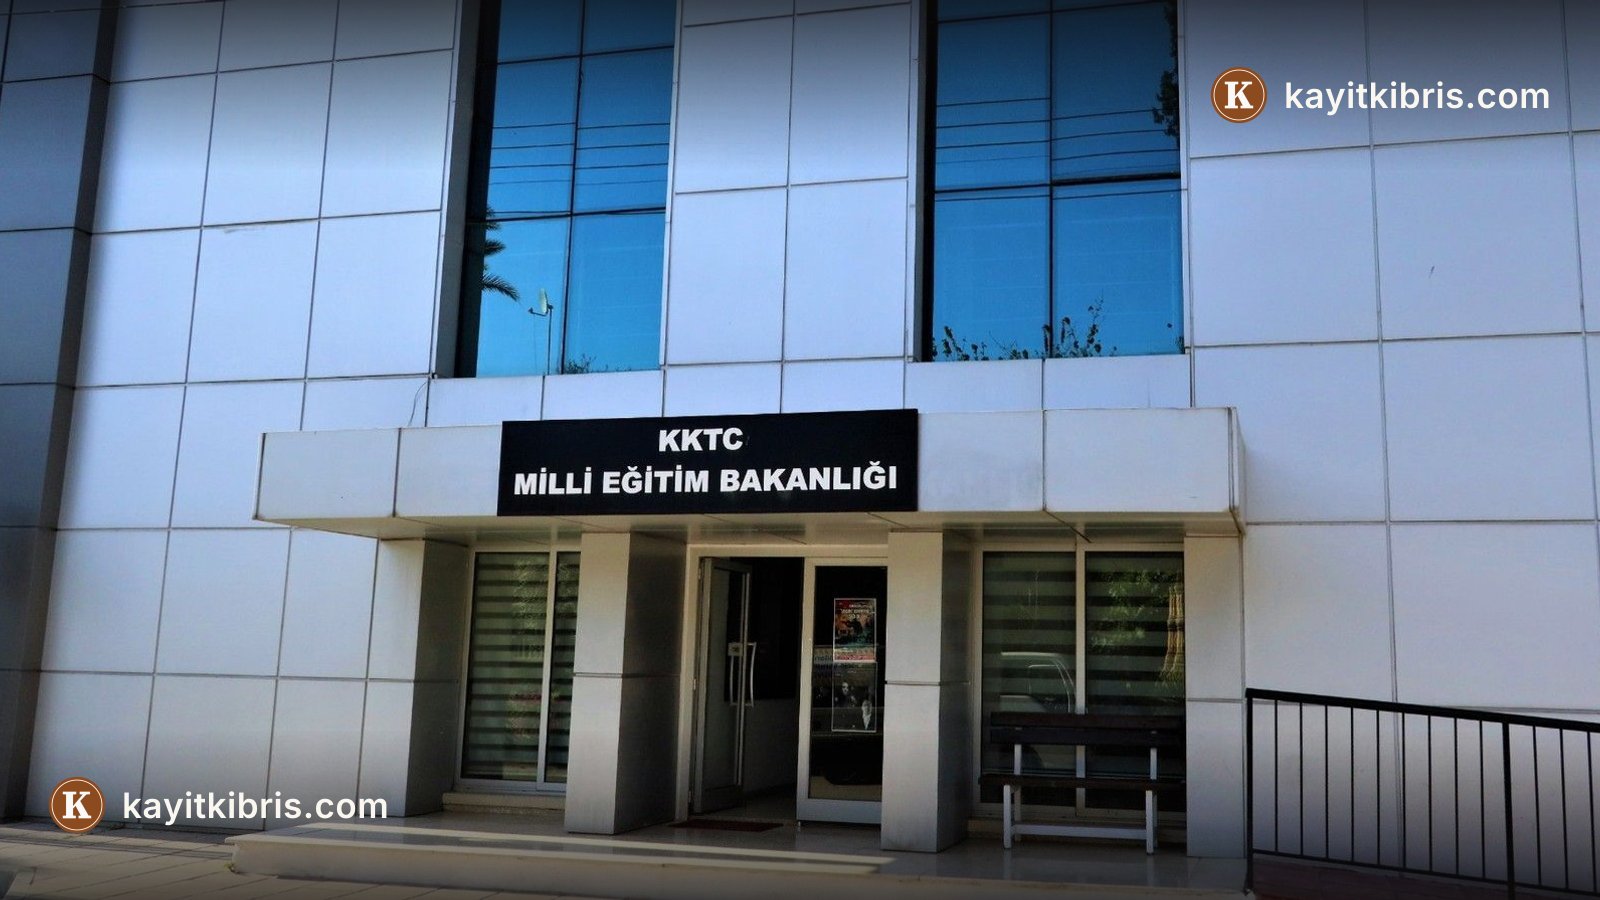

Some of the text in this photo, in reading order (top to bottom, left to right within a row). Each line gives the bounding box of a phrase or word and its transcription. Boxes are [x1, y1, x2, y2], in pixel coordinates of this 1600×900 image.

[658, 427, 744, 452] KKTC
[513, 460, 897, 495] MİLLİ EĞİTİM BAKANLIĞI
